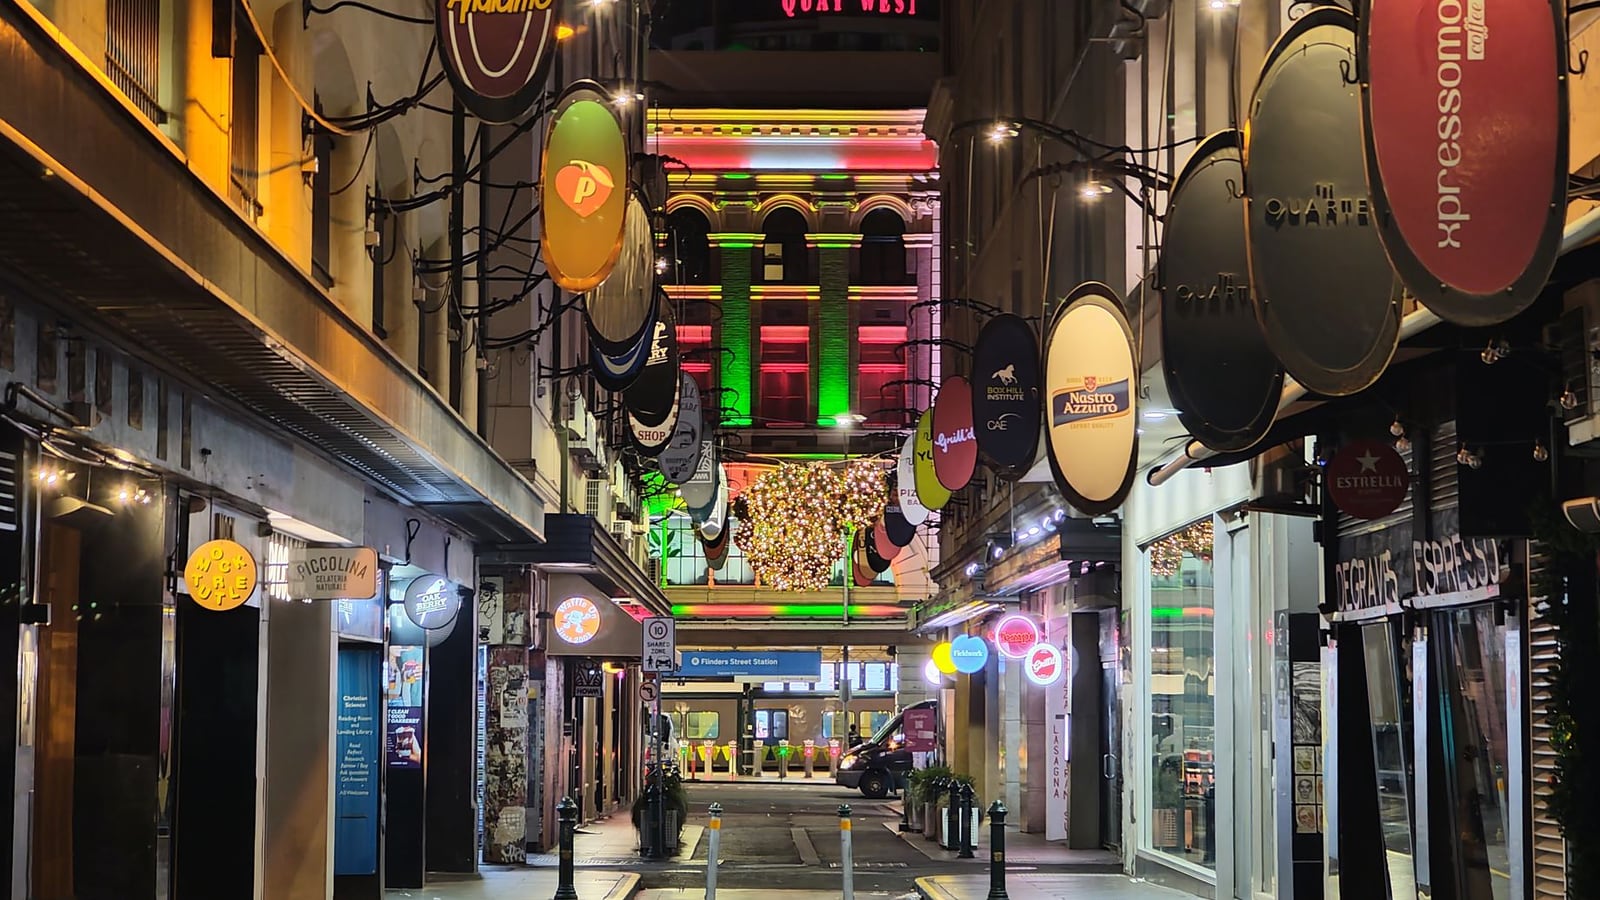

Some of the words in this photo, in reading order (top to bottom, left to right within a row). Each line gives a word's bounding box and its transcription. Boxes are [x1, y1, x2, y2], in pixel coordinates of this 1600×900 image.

[1265, 198, 1370, 221] QUARTE
[1176, 284, 1248, 303] QUART
[986, 386, 1006, 394] BOX
[1006, 386, 1024, 394] HILL
[1070, 392, 1115, 404] Nastro
[1064, 402, 1118, 415] Azzurro
[986, 420, 1008, 431] CAE
[638, 430, 666, 442] SHOP
[934, 427, 977, 453] Grill'd
[1336, 475, 1403, 489] ESTRELLA
[297, 556, 368, 580] PICCOLINA
[315, 575, 347, 583] GELATERIA
[422, 592, 441, 603] OAK
[416, 598, 447, 612] BERRY
[654, 626, 664, 636] 10
[953, 650, 983, 658] Fieldwork
[701, 657, 729, 666] Flinders
[729, 657, 752, 666] Street
[752, 657, 778, 666] Station
[1052, 724, 1060, 799] LASAGNA
